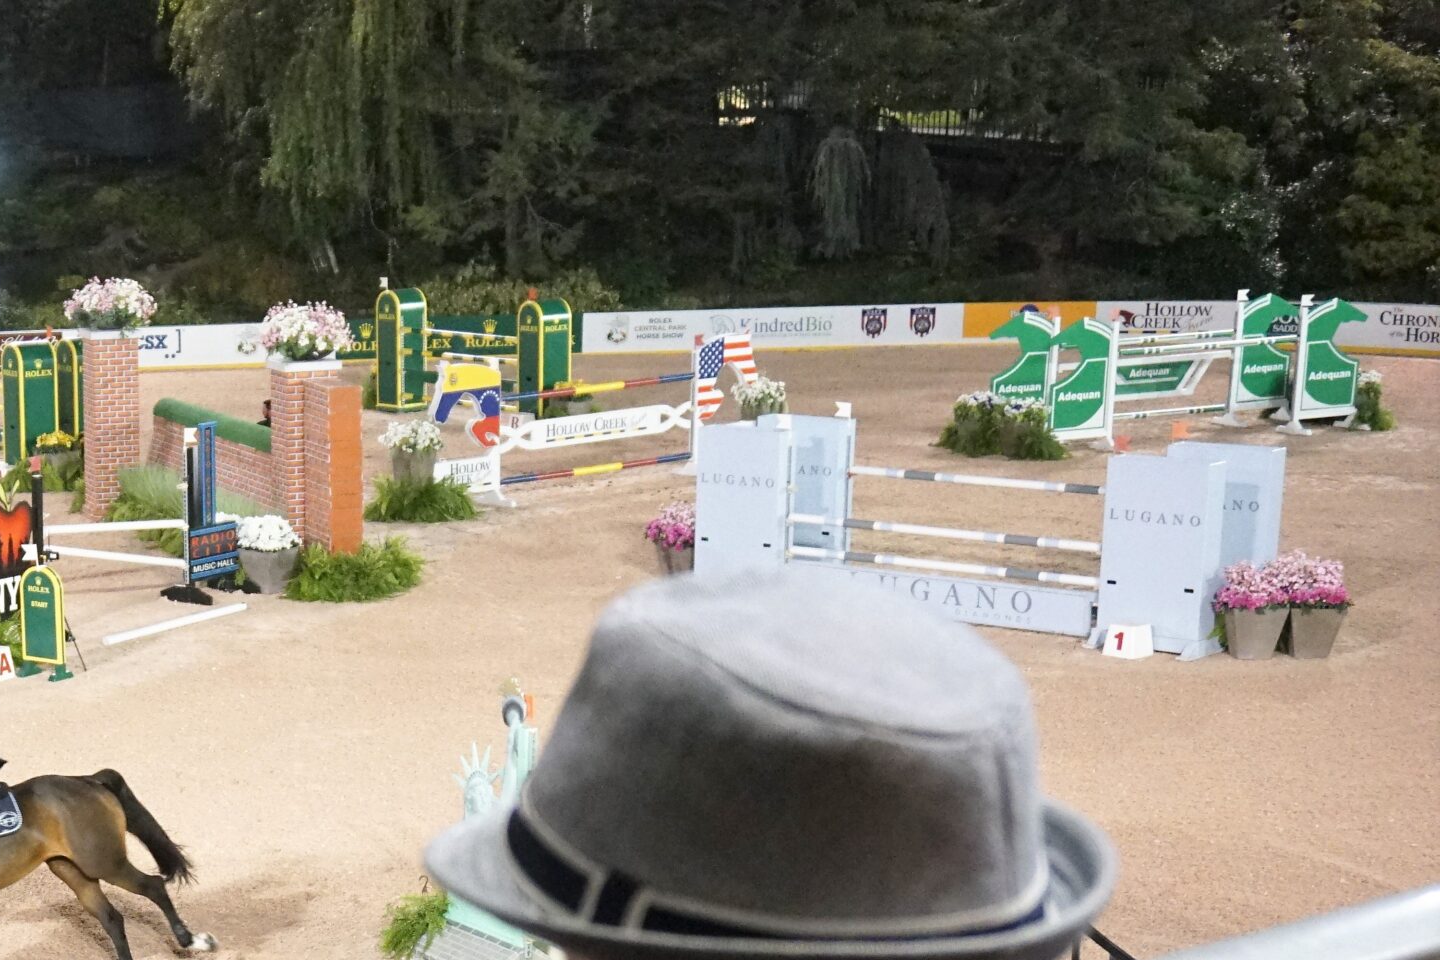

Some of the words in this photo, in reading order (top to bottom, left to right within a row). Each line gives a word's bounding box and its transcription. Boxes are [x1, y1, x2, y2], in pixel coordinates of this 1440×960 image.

[1146, 302, 1213, 317] HOLLOW
[1131, 314, 1181, 329] CREEK
[1380, 310, 1440, 328] CHRON
[545, 323, 568, 333] ROLEX
[1272, 324, 1298, 333] SADD
[25, 369, 53, 378] ROLEX
[1129, 368, 1170, 379] Adequan
[1244, 363, 1284, 375] Adequan
[1308, 370, 1351, 381] Adequan
[998, 384, 1042, 395] Adequan
[1058, 391, 1101, 402] Adequan
[546, 422, 592, 438] HOLLOW
[594, 416, 627, 431] CREEK
[450, 461, 490, 476] HOLLOW
[798, 464, 832, 476] ANO
[701, 472, 775, 489] LUGANO
[1109, 507, 1202, 527] LUGANO
[191, 530, 236, 547] RADIO
[192, 543, 235, 559] CITY
[193, 561, 217, 573] MUSIC
[217, 558, 235, 568] HALL
[27, 585, 50, 594] ROLEX
[878, 574, 1033, 614] GANO
[30, 600, 48, 608] START
[1114, 631, 1125, 651] 1
[0, 652, 12, 676] A
